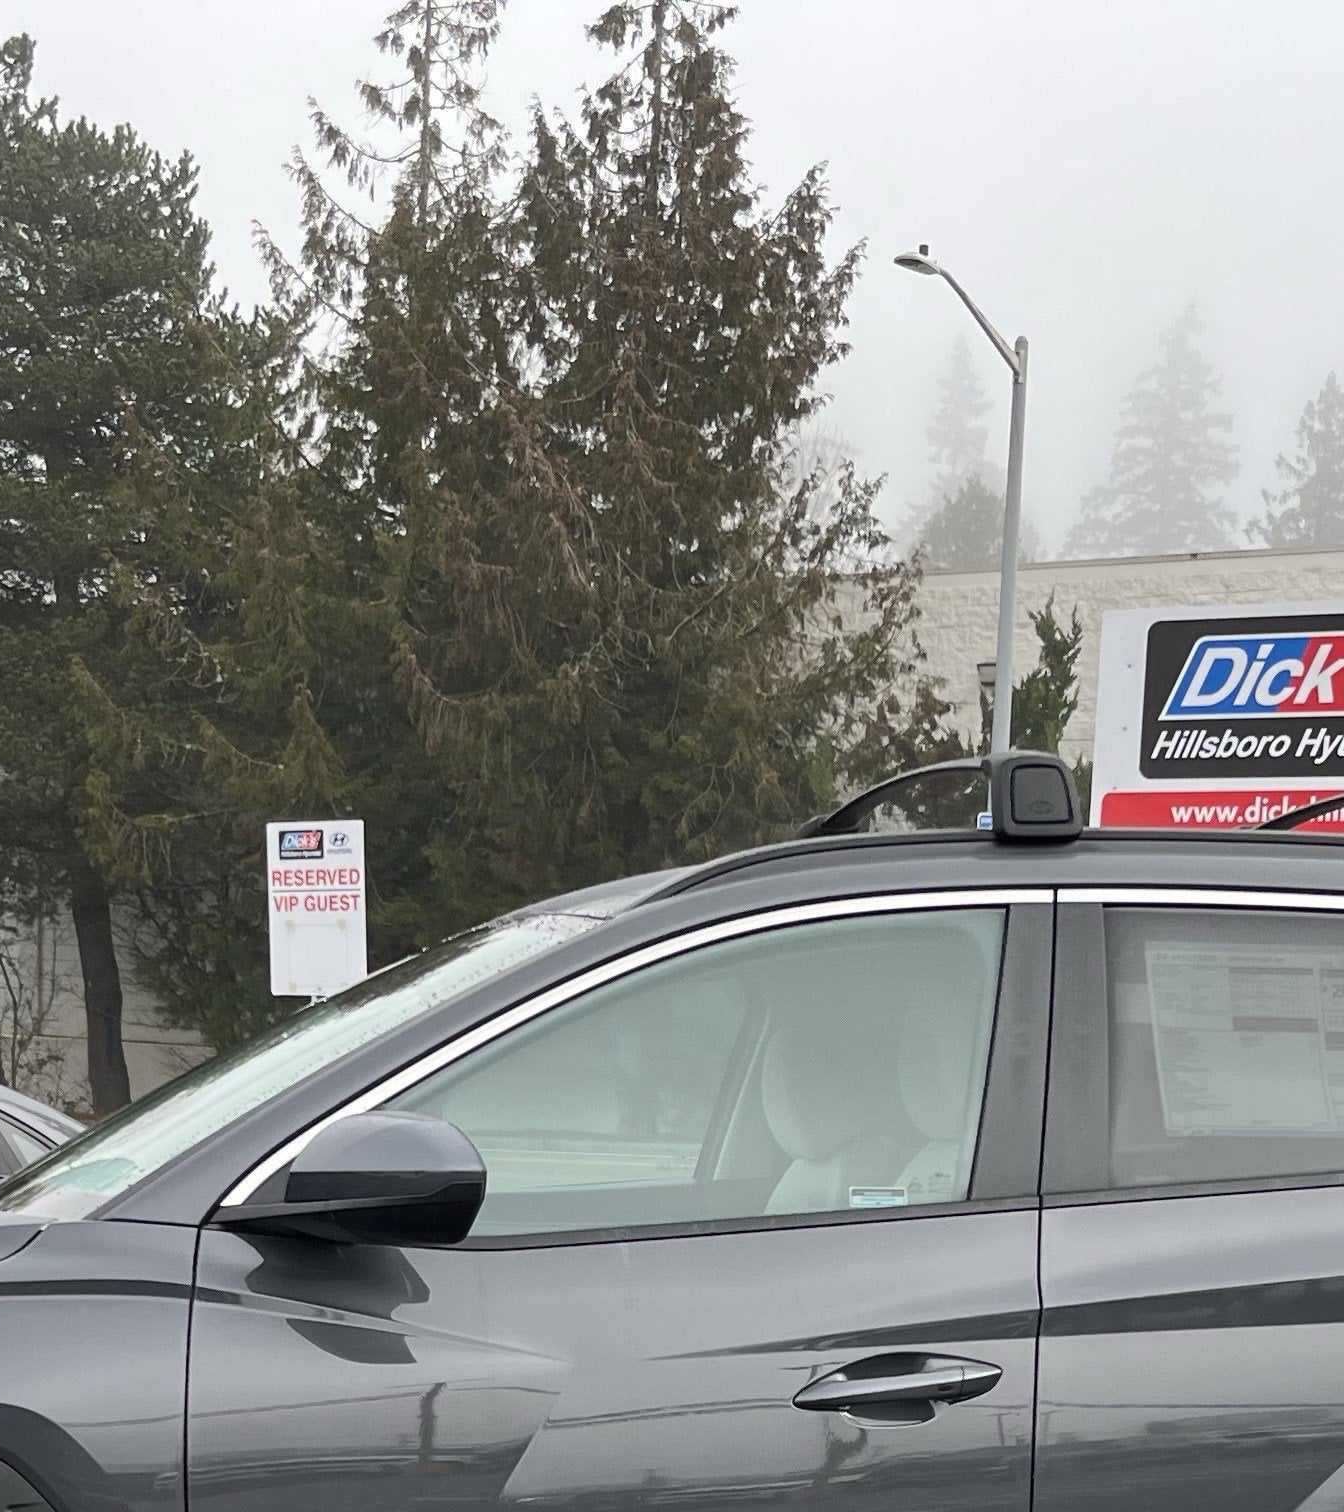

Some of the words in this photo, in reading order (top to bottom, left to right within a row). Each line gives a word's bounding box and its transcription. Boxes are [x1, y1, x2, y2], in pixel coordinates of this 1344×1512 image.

[1151, 729, 1292, 760] Hillsboro
[272, 868, 360, 887] RESERVED
[273, 895, 299, 913] VIP
[304, 894, 361, 912] GUEST
